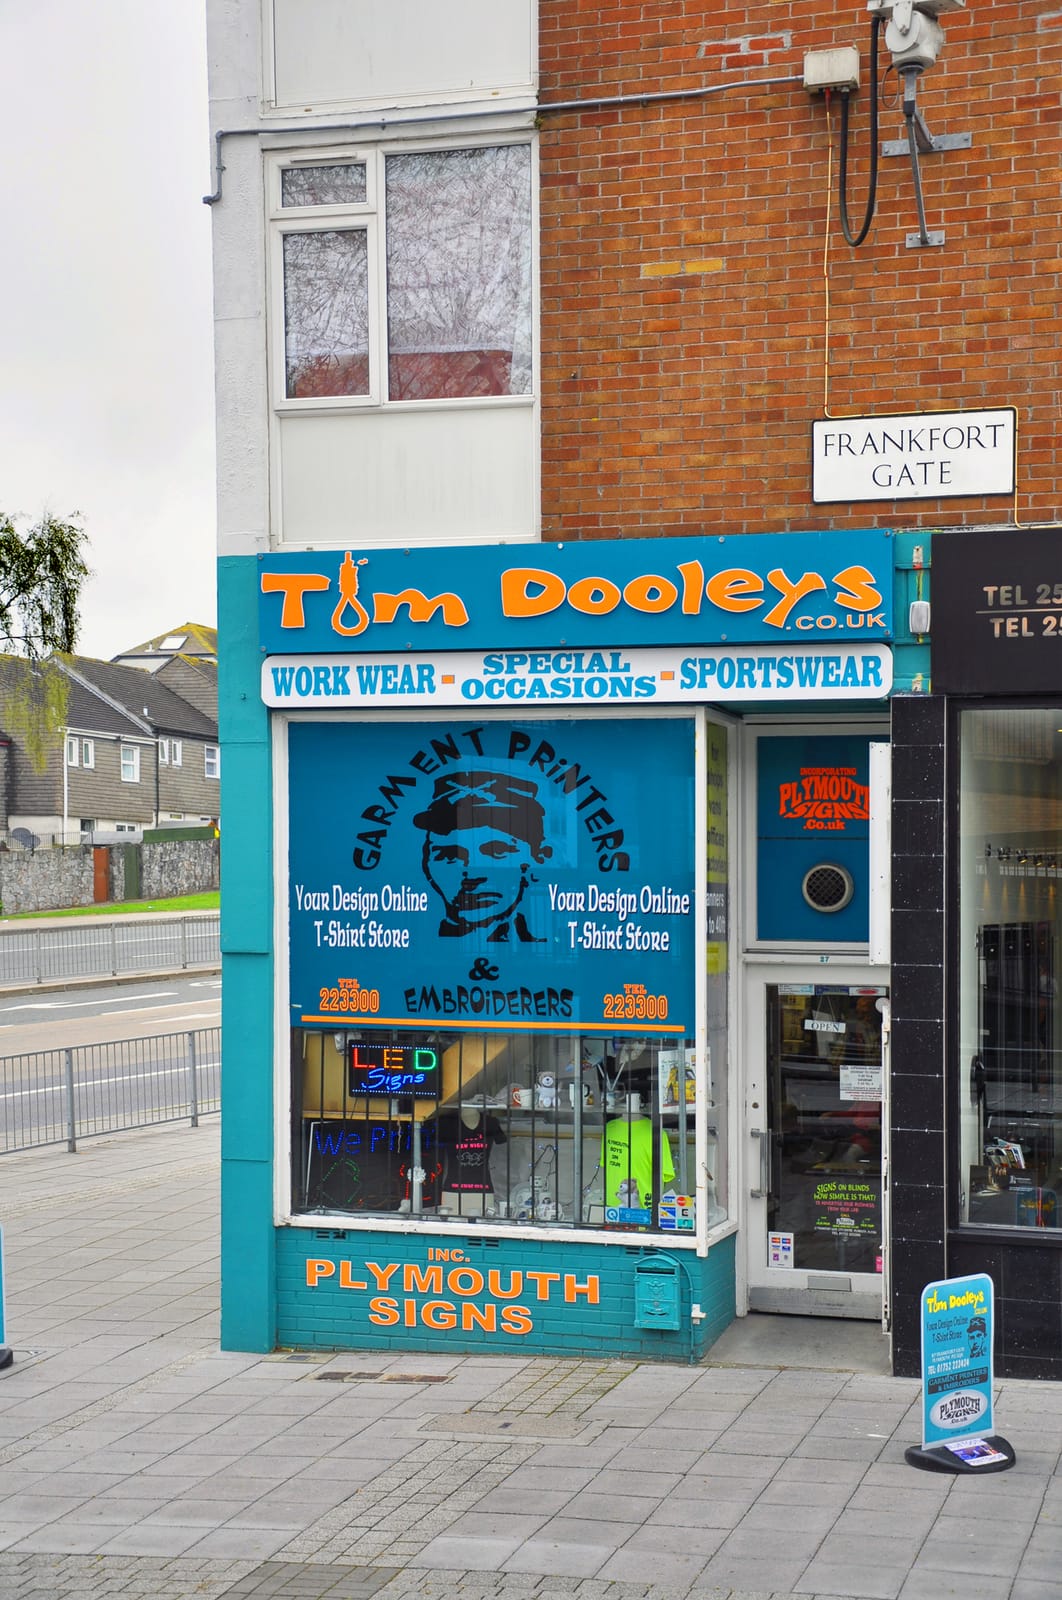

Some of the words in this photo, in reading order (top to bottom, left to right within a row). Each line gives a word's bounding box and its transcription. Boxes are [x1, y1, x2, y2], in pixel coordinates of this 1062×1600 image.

[823, 423, 1005, 457] FRANKFORT
[872, 461, 952, 487] GATE
[261, 551, 469, 637] Tim
[500, 559, 883, 629] Dooleys
[983, 585, 1028, 606] TEL
[786, 613, 886, 631] .CO.UK
[989, 617, 1035, 638] TEL
[1042, 616, 1062, 637] 2
[483, 652, 631, 675] SPECIAL
[680, 655, 882, 690] SPORTSWEAR
[271, 665, 351, 697] WORK
[357, 664, 436, 695] WEAR
[461, 676, 657, 699] OCCASIONS
[353, 728, 485, 871] GARMENT
[784, 801, 870, 820] SIGNS
[295, 884, 331, 911] Your
[333, 884, 379, 920] Design
[381, 886, 428, 912] Online
[549, 883, 586, 912] Your
[589, 884, 637, 921] Design
[639, 884, 690, 915] Online
[314, 920, 367, 948] T-Shirt
[369, 921, 410, 948] Store
[568, 921, 625, 951] T-Shirt
[626, 922, 670, 952] Store
[468, 957, 500, 981] &
[338, 978, 360, 989] TEL
[624, 984, 647, 995] TEL
[319, 988, 380, 1013] 223300
[603, 995, 668, 1020] 223300
[811, 1021, 841, 1033] OPEN
[353, 1047, 437, 1070] LED
[361, 1067, 425, 1091] Signs
[315, 1127, 361, 1156] We
[817, 1182, 836, 1193] SIGNS
[847, 1184, 870, 1192] BLINDS
[428, 1247, 470, 1263] INC.
[306, 1258, 600, 1304] PLYMOUTH
[949, 1290, 984, 1309] Dooleys
[368, 1296, 534, 1335] SIGNS
[940, 1396, 981, 1420] PLYMOUTH
[943, 1408, 978, 1421] SIGNS
